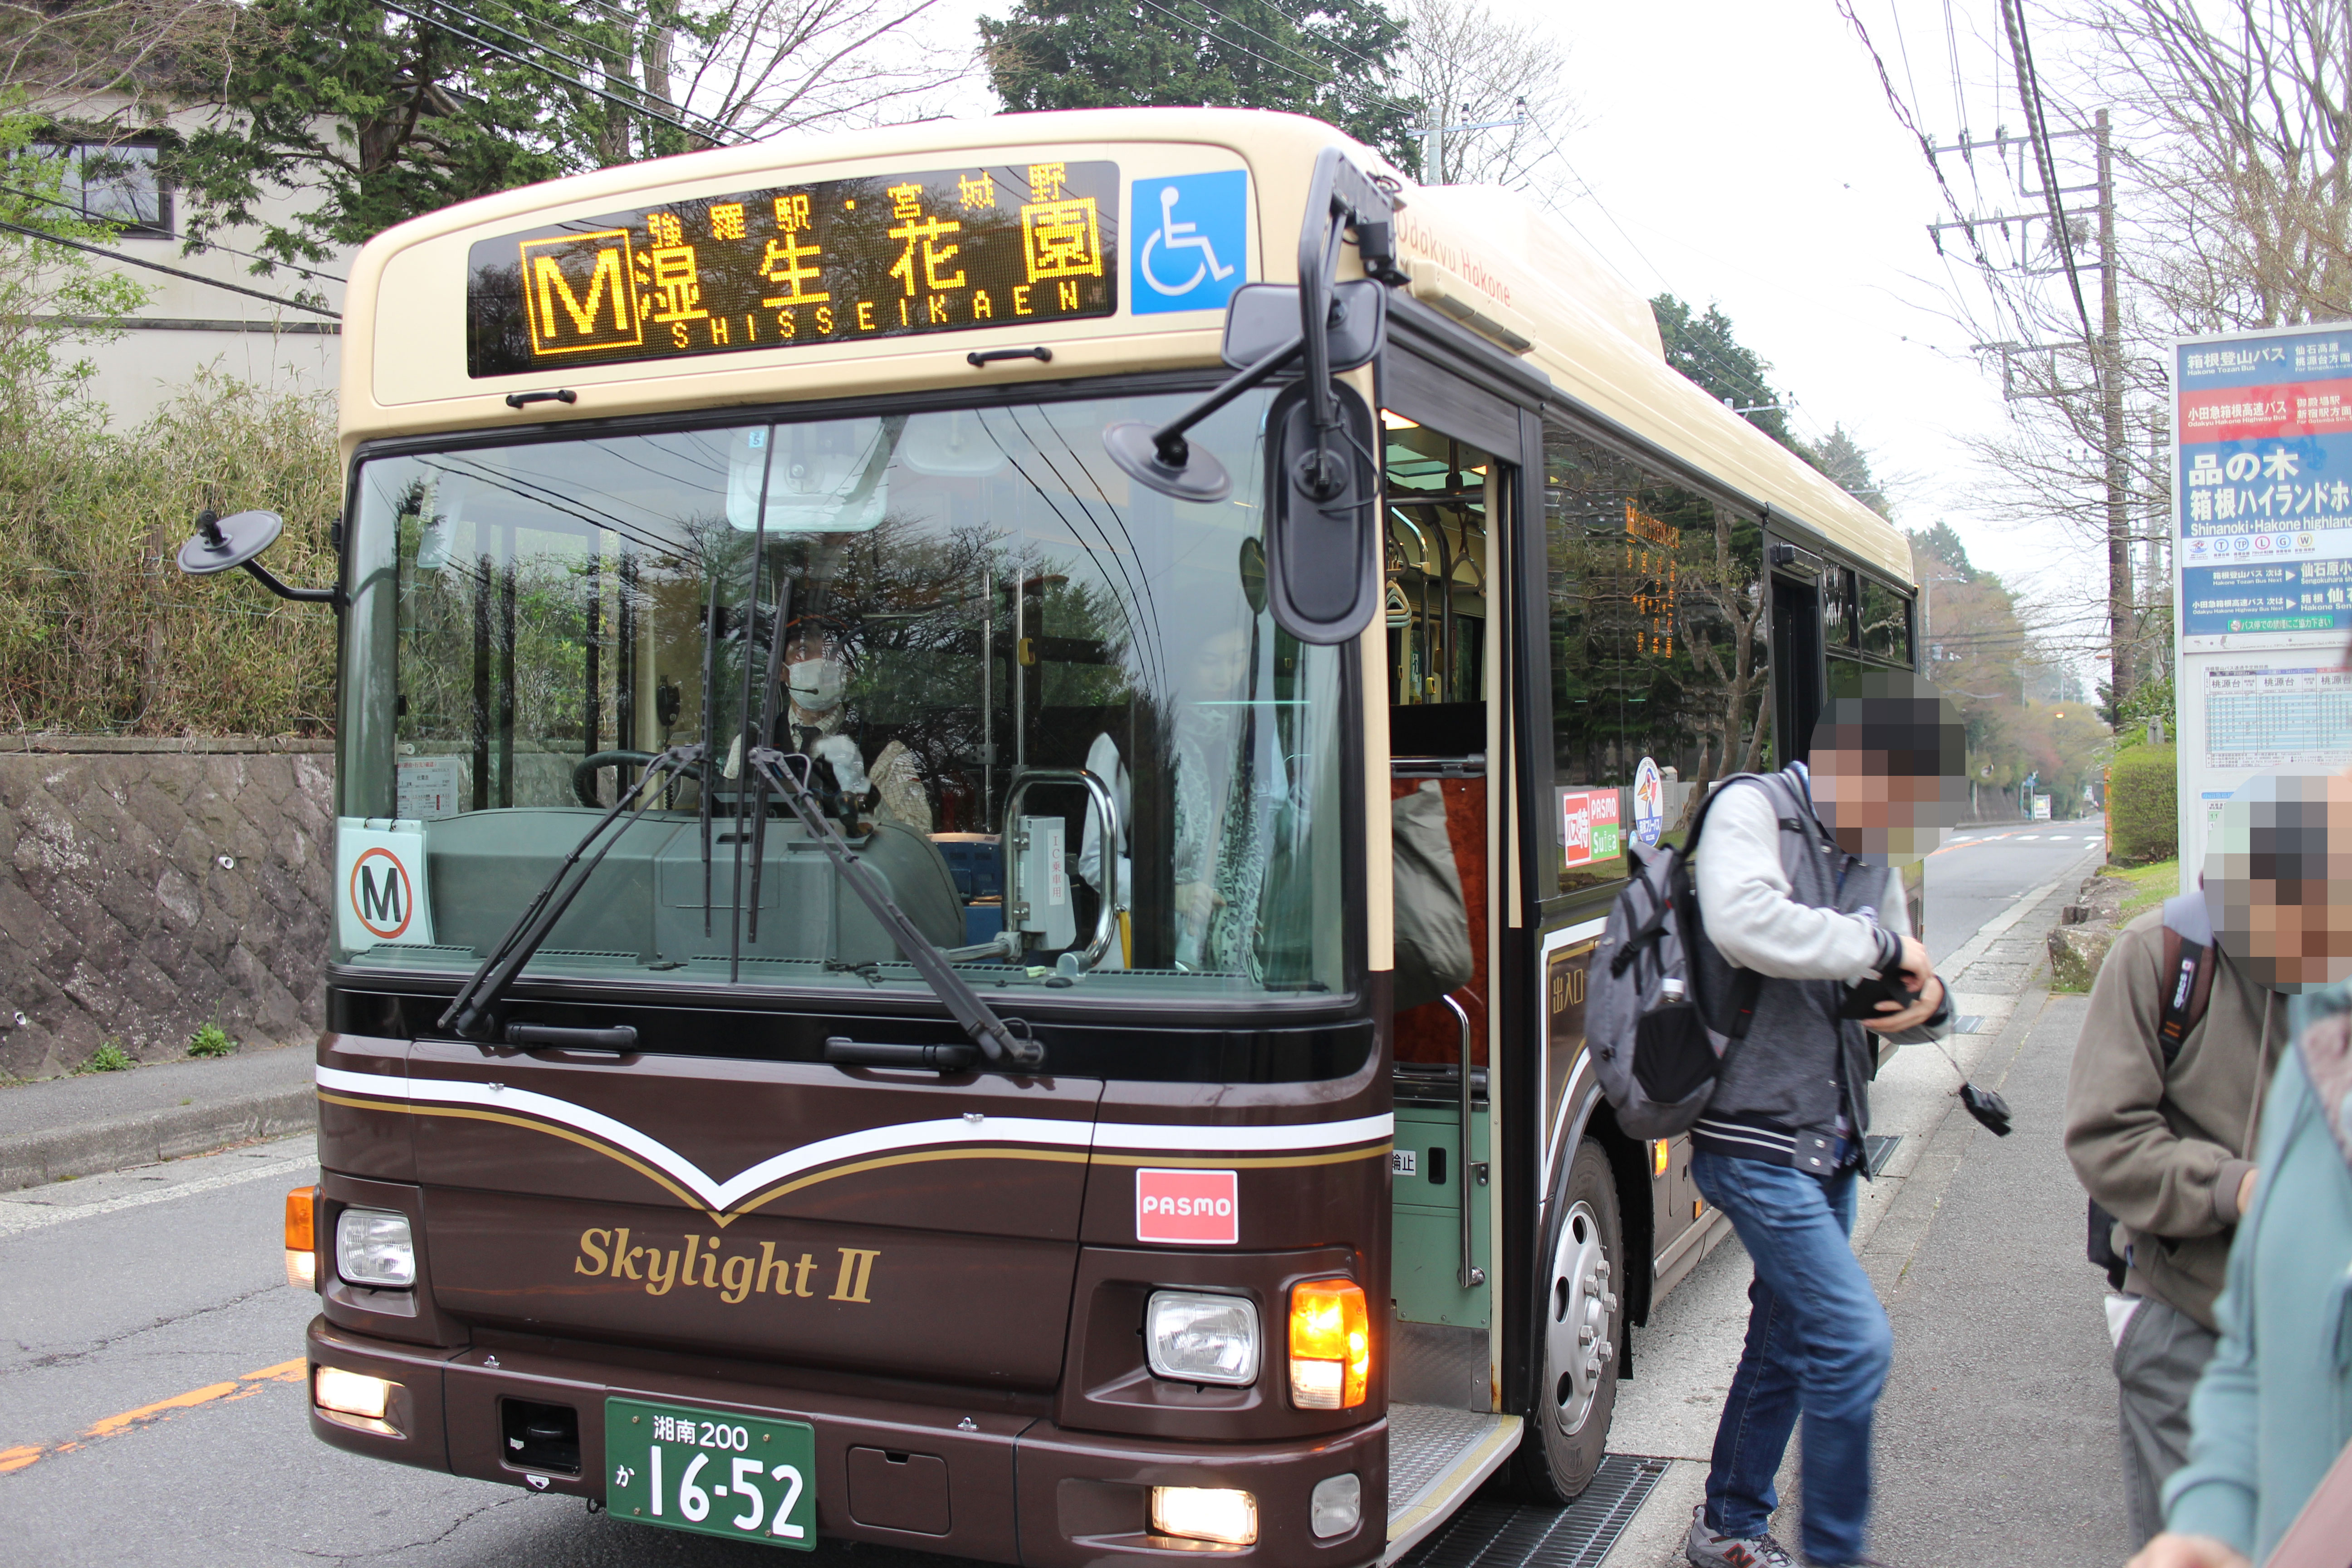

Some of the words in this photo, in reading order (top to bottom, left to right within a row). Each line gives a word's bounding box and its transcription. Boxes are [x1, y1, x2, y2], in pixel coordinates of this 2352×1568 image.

[636, 197, 1103, 323] 湿生花園
[1396, 209, 1456, 272] Odakyu
[1462, 248, 1510, 307] Hakone
[534, 248, 628, 338] M
[671, 280, 1079, 349] SHISSEIKAEN
[2187, 348, 2286, 369] 箱根登山バス
[2295, 343, 2338, 356] 仙石高原
[2307, 363, 2352, 371] Sengoku-koge
[2188, 401, 2287, 421] 小田急箱根高速バス
[2297, 396, 2340, 408] 御殿場駅
[2297, 406, 2351, 419] 新宿駅方面
[2189, 449, 2299, 487] 品の木
[2190, 481, 2352, 521] 箱根ハイランドホ
[2219, 542, 2224, 550] T
[2279, 538, 2286, 546] G
[2213, 569, 2262, 580] 箱根登山バス
[2265, 568, 2283, 577] 次は
[2301, 560, 2352, 578] 仙石原小
[2301, 576, 2344, 584] Sengokuhara
[2192, 598, 2264, 609] 小田急箱根高速バス
[2267, 597, 2283, 605] 次は
[2241, 617, 2331, 630] バス停での禁煙にご協力下さい
[2212, 679, 2241, 689] 桃源台
[2264, 677, 2294, 687] 桃源台
[2321, 675, 2352, 686] 桃源台
[1591, 797, 1617, 820] PASMO
[1593, 831, 1617, 853] Suica
[1052, 836, 1062, 898] IC乗車用
[362, 865, 402, 923] M
[1553, 968, 1583, 1014] 出入口
[1142, 1196, 1231, 1217] PASMO
[574, 1227, 818, 1304] Skylight
[653, 1414, 697, 1446] 湘南
[699, 1421, 749, 1452] 200
[615, 1464, 635, 1488] か
[651, 1445, 804, 1539] 16-52
